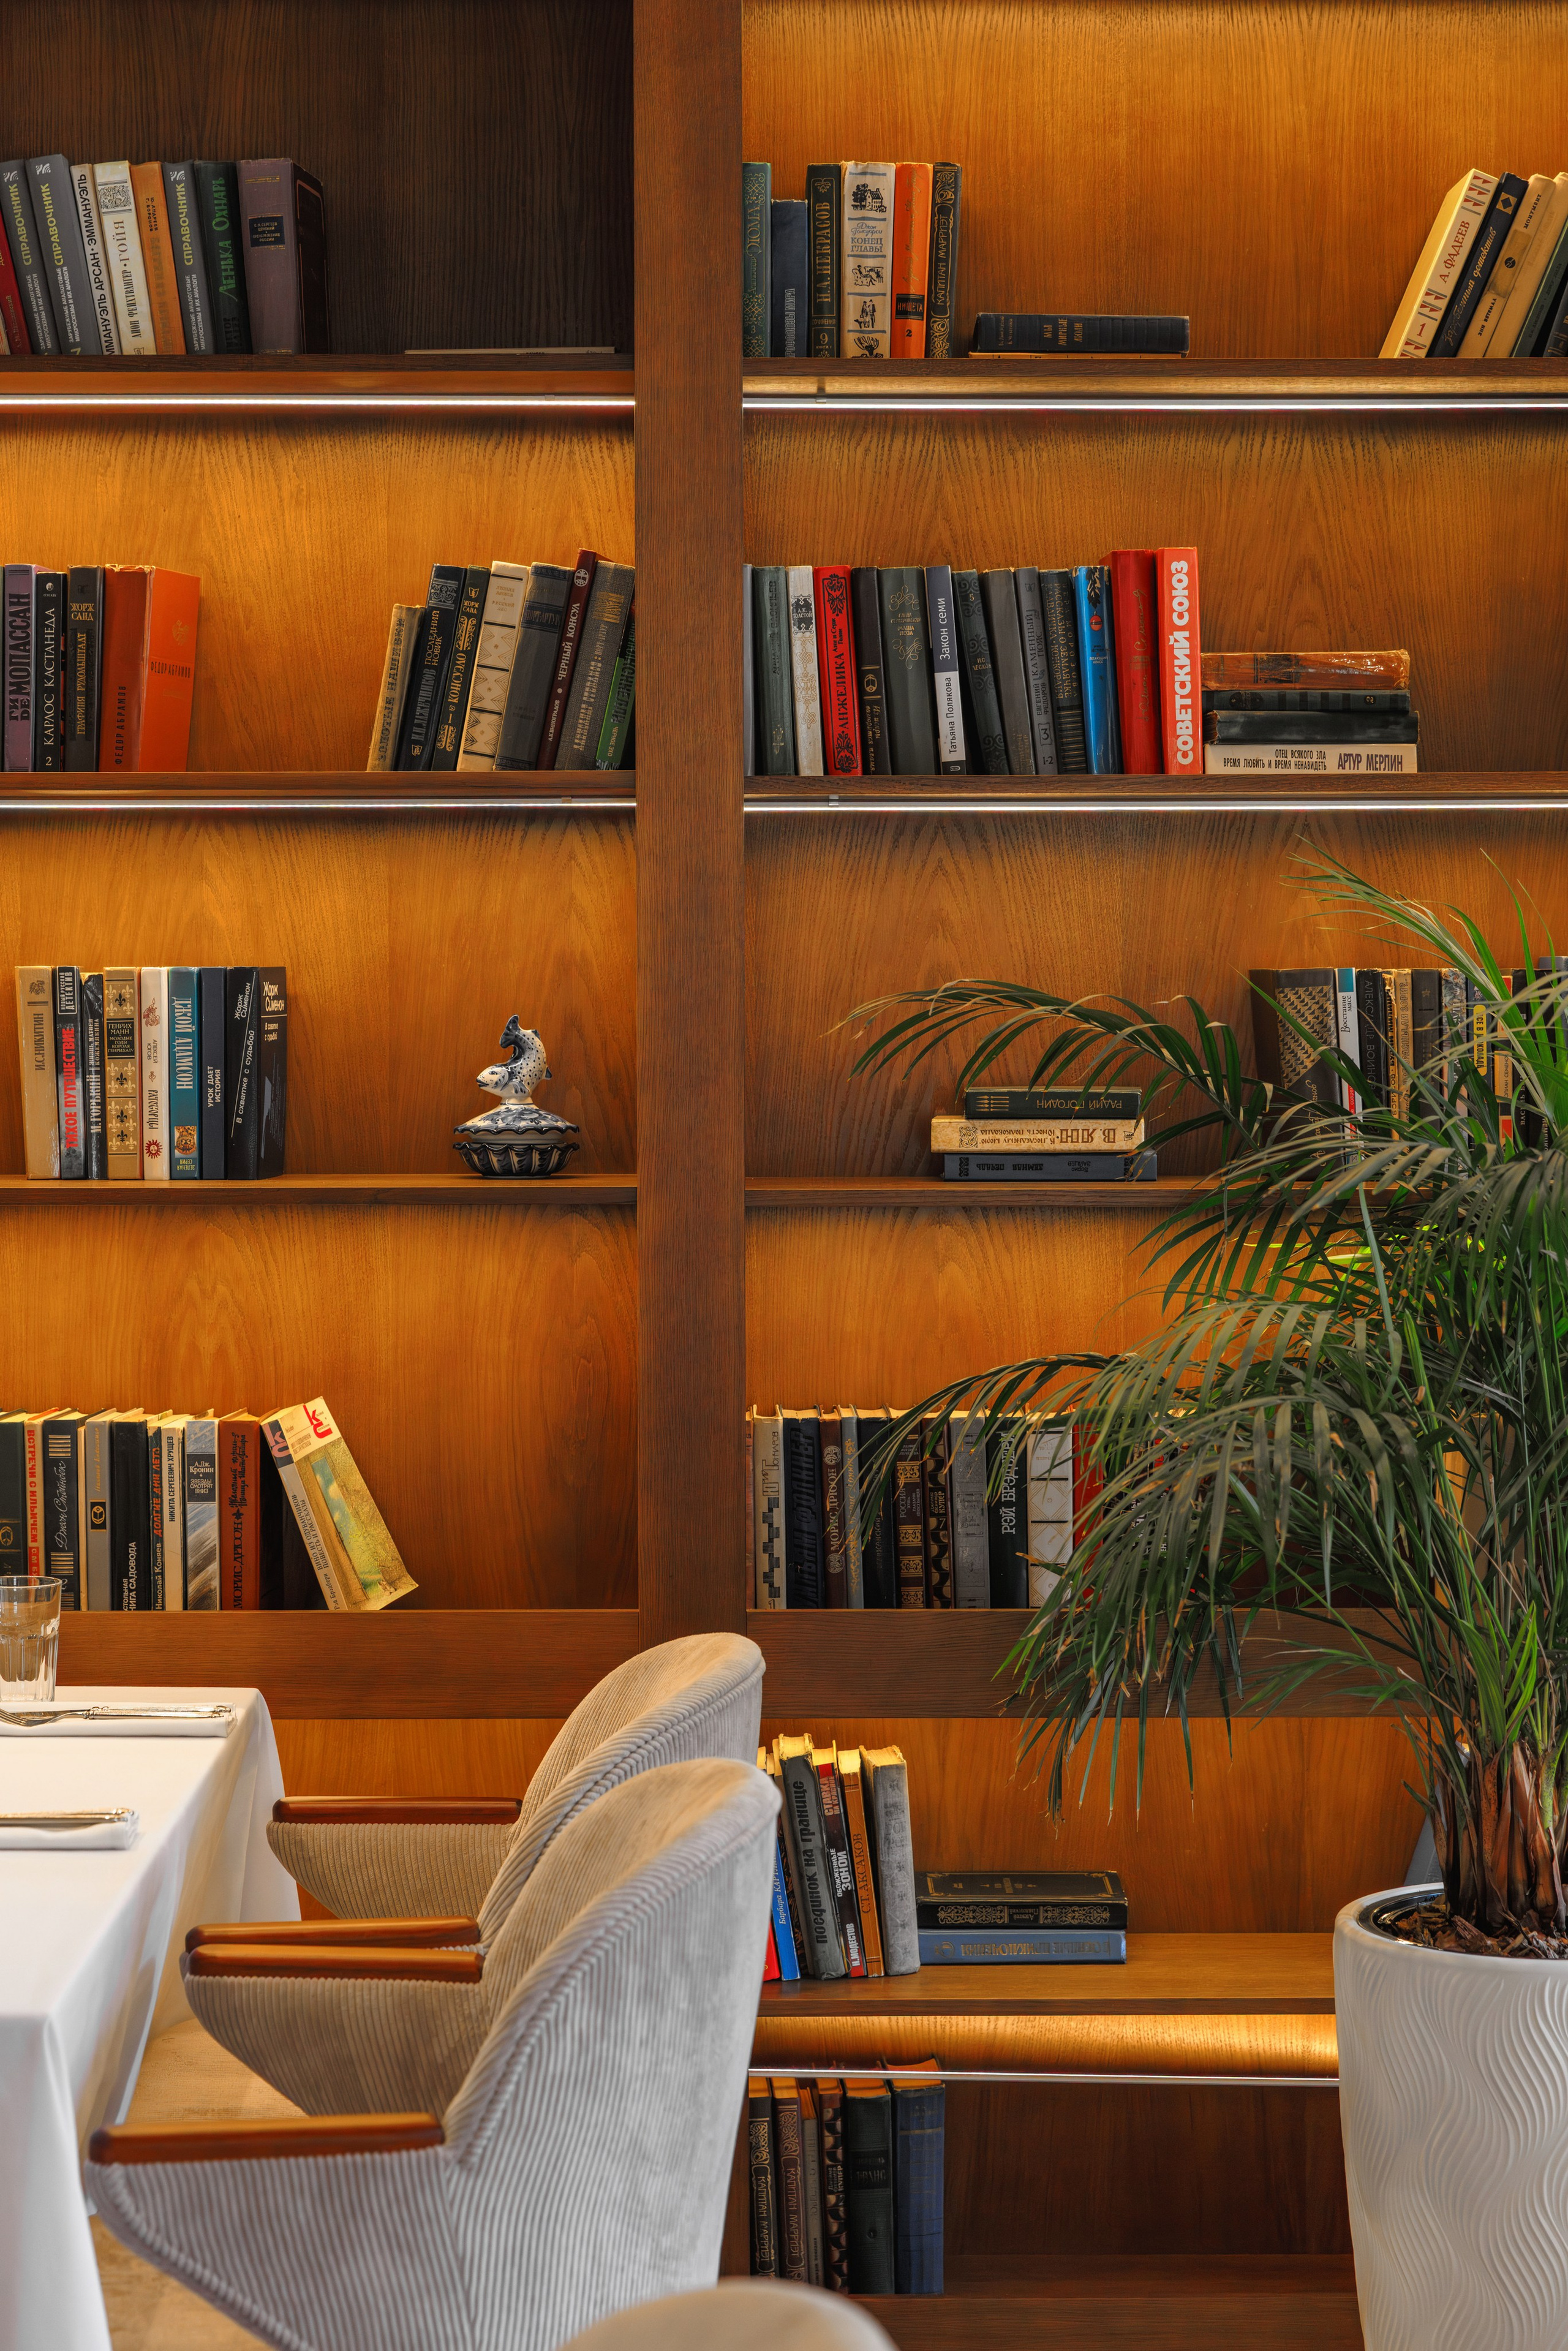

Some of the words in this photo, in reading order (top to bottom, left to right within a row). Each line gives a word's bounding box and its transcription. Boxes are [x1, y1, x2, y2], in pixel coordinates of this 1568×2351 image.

[9, 184, 32, 266] СПРАВОЧНИК
[40, 183, 63, 266] СПРАВОЧНИК
[78, 175, 97, 246] ЭММАНУЭЛЬ
[176, 183, 193, 266] СПРАВОЧНИК
[112, 220, 129, 262] ГОЙЯ
[816, 202, 831, 275] НЕКРАСОВ
[850, 237, 883, 246] КОНЕЦ
[938, 214, 948, 259] МАРРИЭТ
[1444, 220, 1471, 268] ФАДЕЕВ
[1473, 226, 1497, 278] детектив
[32, 273, 42, 298] АНАЛОГИ
[56, 267, 67, 305] АНАЛОГОВЫЕ
[62, 266, 71, 292] АНАЛОГИ
[90, 252, 104, 290] АРСАН
[191, 274, 200, 298] АНАЛОГИ
[936, 263, 947, 306] КАПИТАН
[1439, 269, 1450, 284] А.
[26, 274, 38, 312] АНАЛОГОВЫЕ
[185, 274, 194, 314] АНАЛОГОВЫЕ
[785, 288, 796, 311] МИРА
[897, 302, 924, 312] НИЩЕТА
[32, 312, 45, 350] ЗАРУБЕЖНЫЕ
[40, 311, 51, 349] МИКРОСХЕМЫ
[63, 305, 74, 343] ЗАРУБЕЖНЫЕ
[68, 304, 80, 342] МИКРОСХЕМЫ
[129, 320, 141, 338] ЛИОН
[189, 314, 199, 351] ЗАРУБЕЖНЫЕ
[195, 312, 205, 350] МИКРОСХЕМЫ
[820, 333, 828, 344] 9
[1058, 317, 1068, 346] МИРНЫЕ
[1074, 323, 1083, 342] ЛЮДИ
[1417, 323, 1426, 337] 1
[70, 603, 95, 611] ЖОРЖ
[938, 597, 948, 625] семи
[1170, 559, 1190, 627] СОЮЗ
[71, 611, 94, 621] САНД
[9, 593, 31, 697] МОПАССАН
[43, 608, 55, 687] КАСТАНЕДА
[424, 610, 440, 665] ПОСЛЕДНИЙ
[432, 636, 443, 666] НОВИК
[557, 641, 573, 681] ЧЕРНЫЙ
[566, 602, 581, 638] КОНСУЛ
[940, 628, 951, 660] Закон
[1025, 614, 1039, 676] КАМЕННЫЙ
[1054, 583, 1066, 635] РАССКАЗЫ
[1060, 645, 1072, 698] ЗЕМЛЯЧКЕ
[448, 652, 467, 703] КОНСУЭЛО
[1066, 620, 1077, 697] МОРОЗОВА
[9, 698, 19, 722] ГИ
[116, 686, 127, 731] АБРАМОВ
[835, 652, 849, 730] АНЖЕЛИКА
[946, 677, 955, 719] Полякова
[1033, 683, 1042, 717] ЕВГЕНИЙ
[1039, 682, 1049, 715] ФЕДОРОВ
[1169, 630, 1194, 766] СОВЕТСКИЙ
[43, 693, 55, 745] КАРЛОС
[77, 696, 86, 735] ГРАФИНЯ
[1041, 728, 1049, 740] 3
[115, 733, 124, 764] ФЕДОР
[949, 721, 957, 754] Татьяна
[1275, 749, 1288, 760] ОТЕЦ
[1291, 750, 1314, 760] ВСЯКОГО
[1316, 750, 1326, 760] ЗЛА
[45, 757, 52, 766] 2
[1223, 758, 1241, 768] ВРЕМЯ
[1243, 758, 1265, 769] ЛЮБИТЬ
[1268, 760, 1272, 769] И
[1275, 760, 1292, 769] ВРЕМЯ
[1294, 760, 1327, 771] НЕНАВИДЕТЬ
[1338, 753, 1362, 771] АРТУР
[1366, 753, 1403, 772] МЕРЛИН
[64, 971, 75, 1010] ДЕТЕКТИВ
[234, 992, 244, 1021] Жорж
[240, 982, 251, 1019] Сименон
[263, 981, 279, 997] Жорж
[265, 998, 285, 1013] Сименон
[172, 997, 195, 1033] ДЖОЙ
[1340, 995, 1351, 1033] Восстание
[62, 1027, 77, 1108] ПУТЕШЕСТВИЕ
[173, 1036, 194, 1090] АДАМСОН
[238, 1077, 249, 1115] схватке
[245, 1029, 255, 1066] судьбой
[1037, 1100, 1085, 1109] ПОГОДИН
[1089, 1100, 1123, 1110] РАДИЙ
[65, 1111, 78, 1149] ТИХОЕ
[1059, 1128, 1097, 1143] ЯН
[1100, 1128, 1117, 1143] В.
[976, 1163, 1005, 1172] ПЕЧАЛЬ
[1012, 1163, 1044, 1172] ЗЕМНАЯ
[26, 1429, 37, 1478] ВСТРЕЧИ
[762, 1431, 780, 1470] ГОНЧАРОВ
[826, 1466, 839, 1510] ДРЮОН
[29, 1490, 38, 1544] ИЛЬИЧЕМ
[53, 1514, 68, 1551] Джон
[153, 1498, 163, 1537] ДОЛГИЕ
[829, 1513, 840, 1552] МОРИС
[939, 1518, 946, 1529] 7
[999, 1507, 1016, 1534] РЭЙ
[233, 1519, 245, 1565] ДРЮОН
[233, 1565, 244, 1610] МОРИС
[793, 1780, 815, 1843] границе
[819, 1776, 834, 1816] СТАВКА
[829, 1847, 842, 1898] ОБОЖЖЕННЫЕ
[836, 1851, 852, 1891] ЗОНОЙ
[853, 1833, 871, 1892] АКСАКОВ
[778, 1893, 787, 1925] Барбара
[807, 1872, 828, 1944] поединок
[756, 2175, 767, 2217] КАПИТАН
[786, 2167, 798, 2211] КАПИТАН
[758, 2221, 770, 2262] МАРРИЭТ
